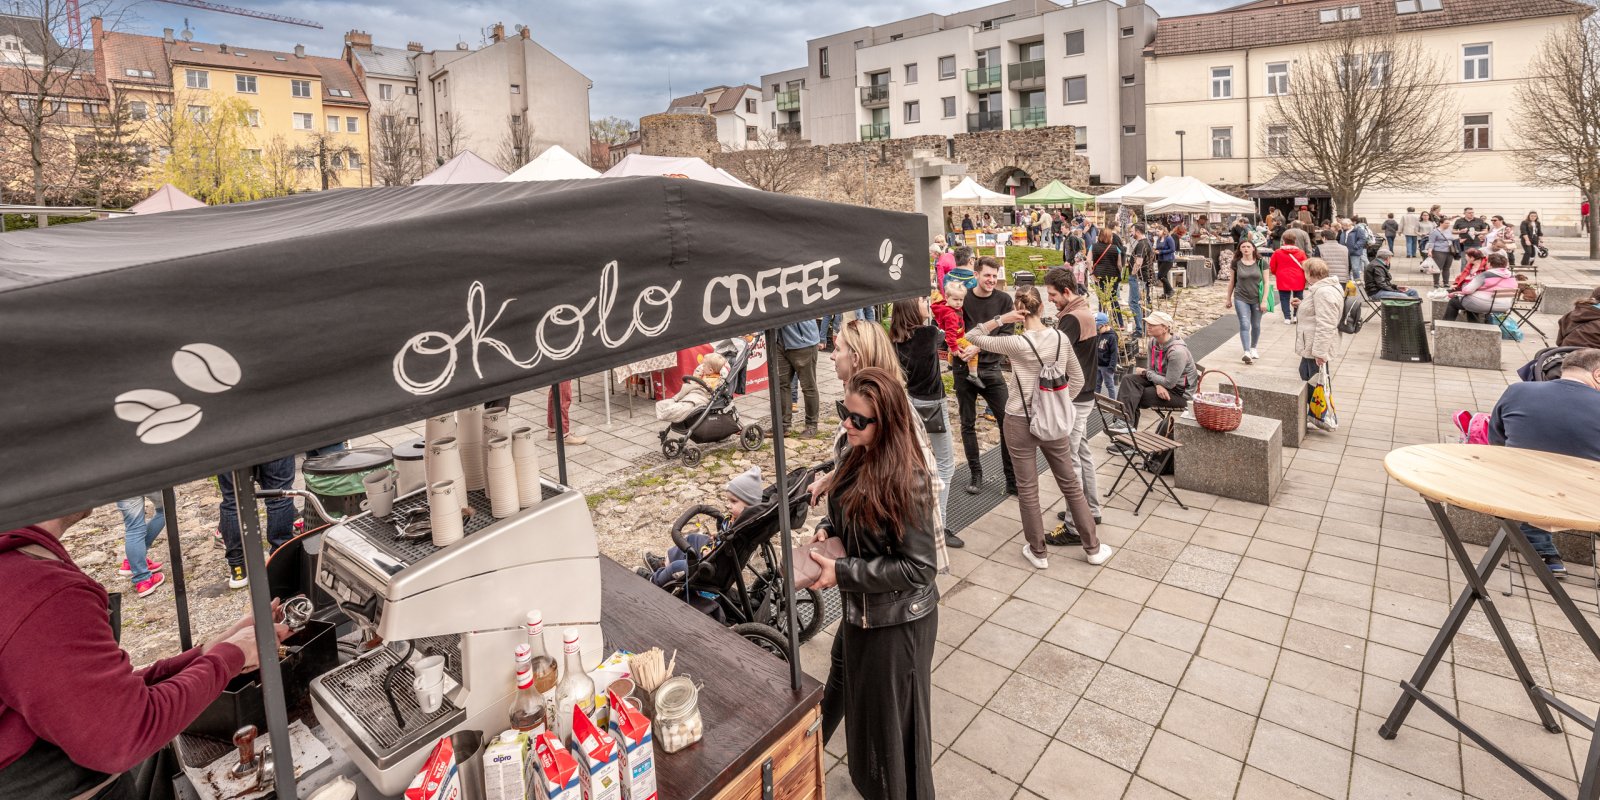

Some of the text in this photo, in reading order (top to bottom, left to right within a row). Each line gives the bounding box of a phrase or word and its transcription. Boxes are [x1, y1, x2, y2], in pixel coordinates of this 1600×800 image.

[392, 257, 841, 395] okolo COFFEE
[493, 754, 512, 763] alpro
